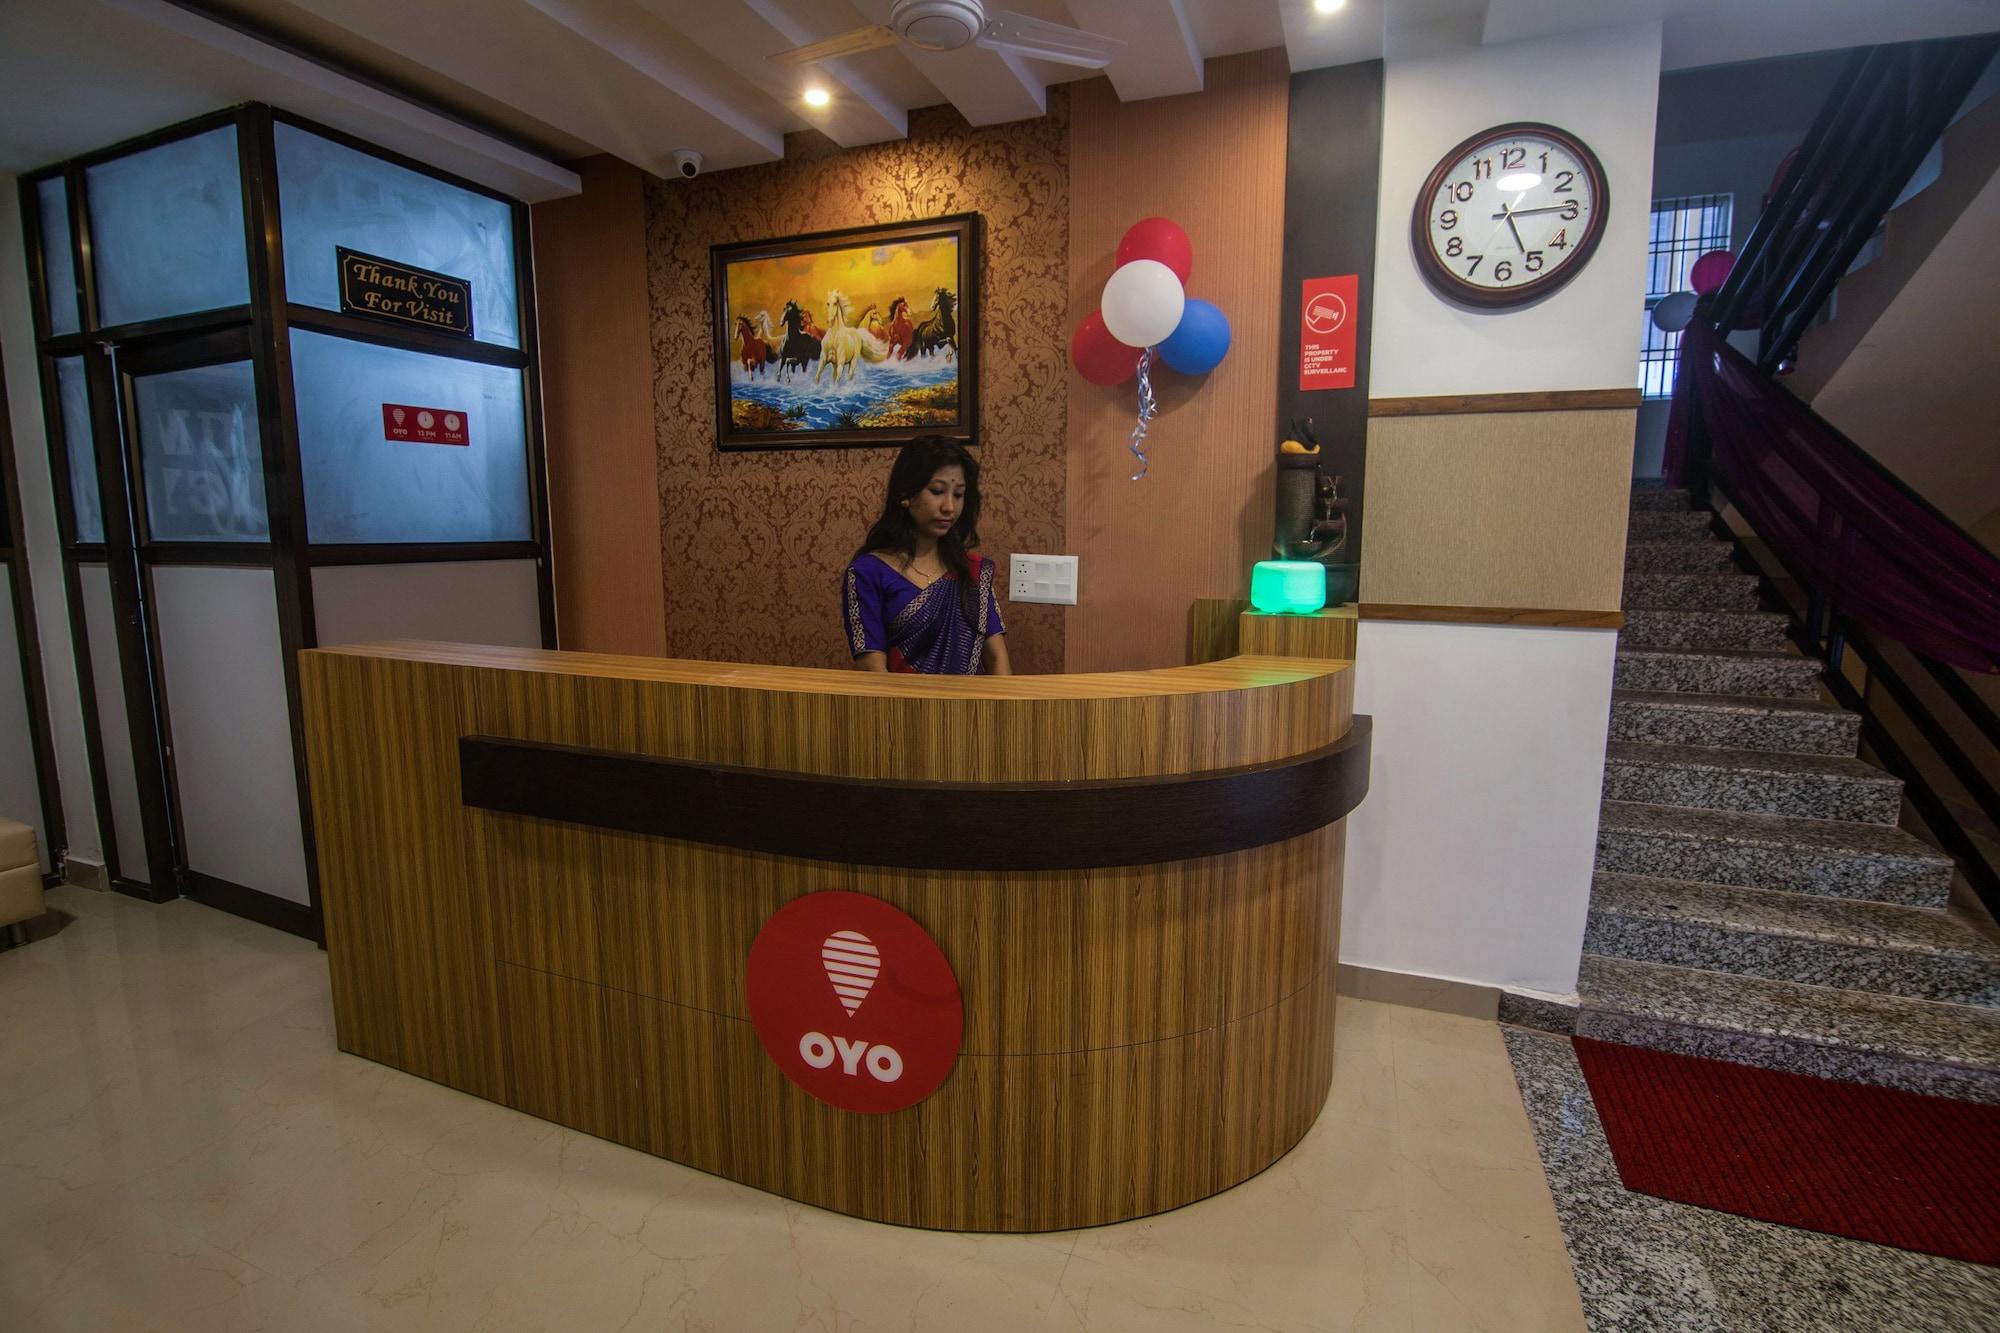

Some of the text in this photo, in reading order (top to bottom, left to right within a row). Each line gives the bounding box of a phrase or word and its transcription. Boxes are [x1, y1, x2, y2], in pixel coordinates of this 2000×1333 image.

[1473, 157, 1493, 180] 11
[1500, 147, 1527, 170] 12
[1539, 152, 1549, 174] 1
[1448, 181, 1474, 204] 10
[1553, 171, 1574, 193] 2
[1440, 209, 1458, 230] 9
[1560, 199, 1579, 221] 3
[1446, 236, 1463, 258] 8
[1549, 228, 1568, 250] 4
[1466, 255, 1484, 277] 7
[1494, 260, 1513, 282] 6
[1525, 250, 1544, 273] 5
[353, 263, 460, 304] Thank You
[364, 291, 454, 324] For Visit
[800, 1031, 904, 1083] OYO
